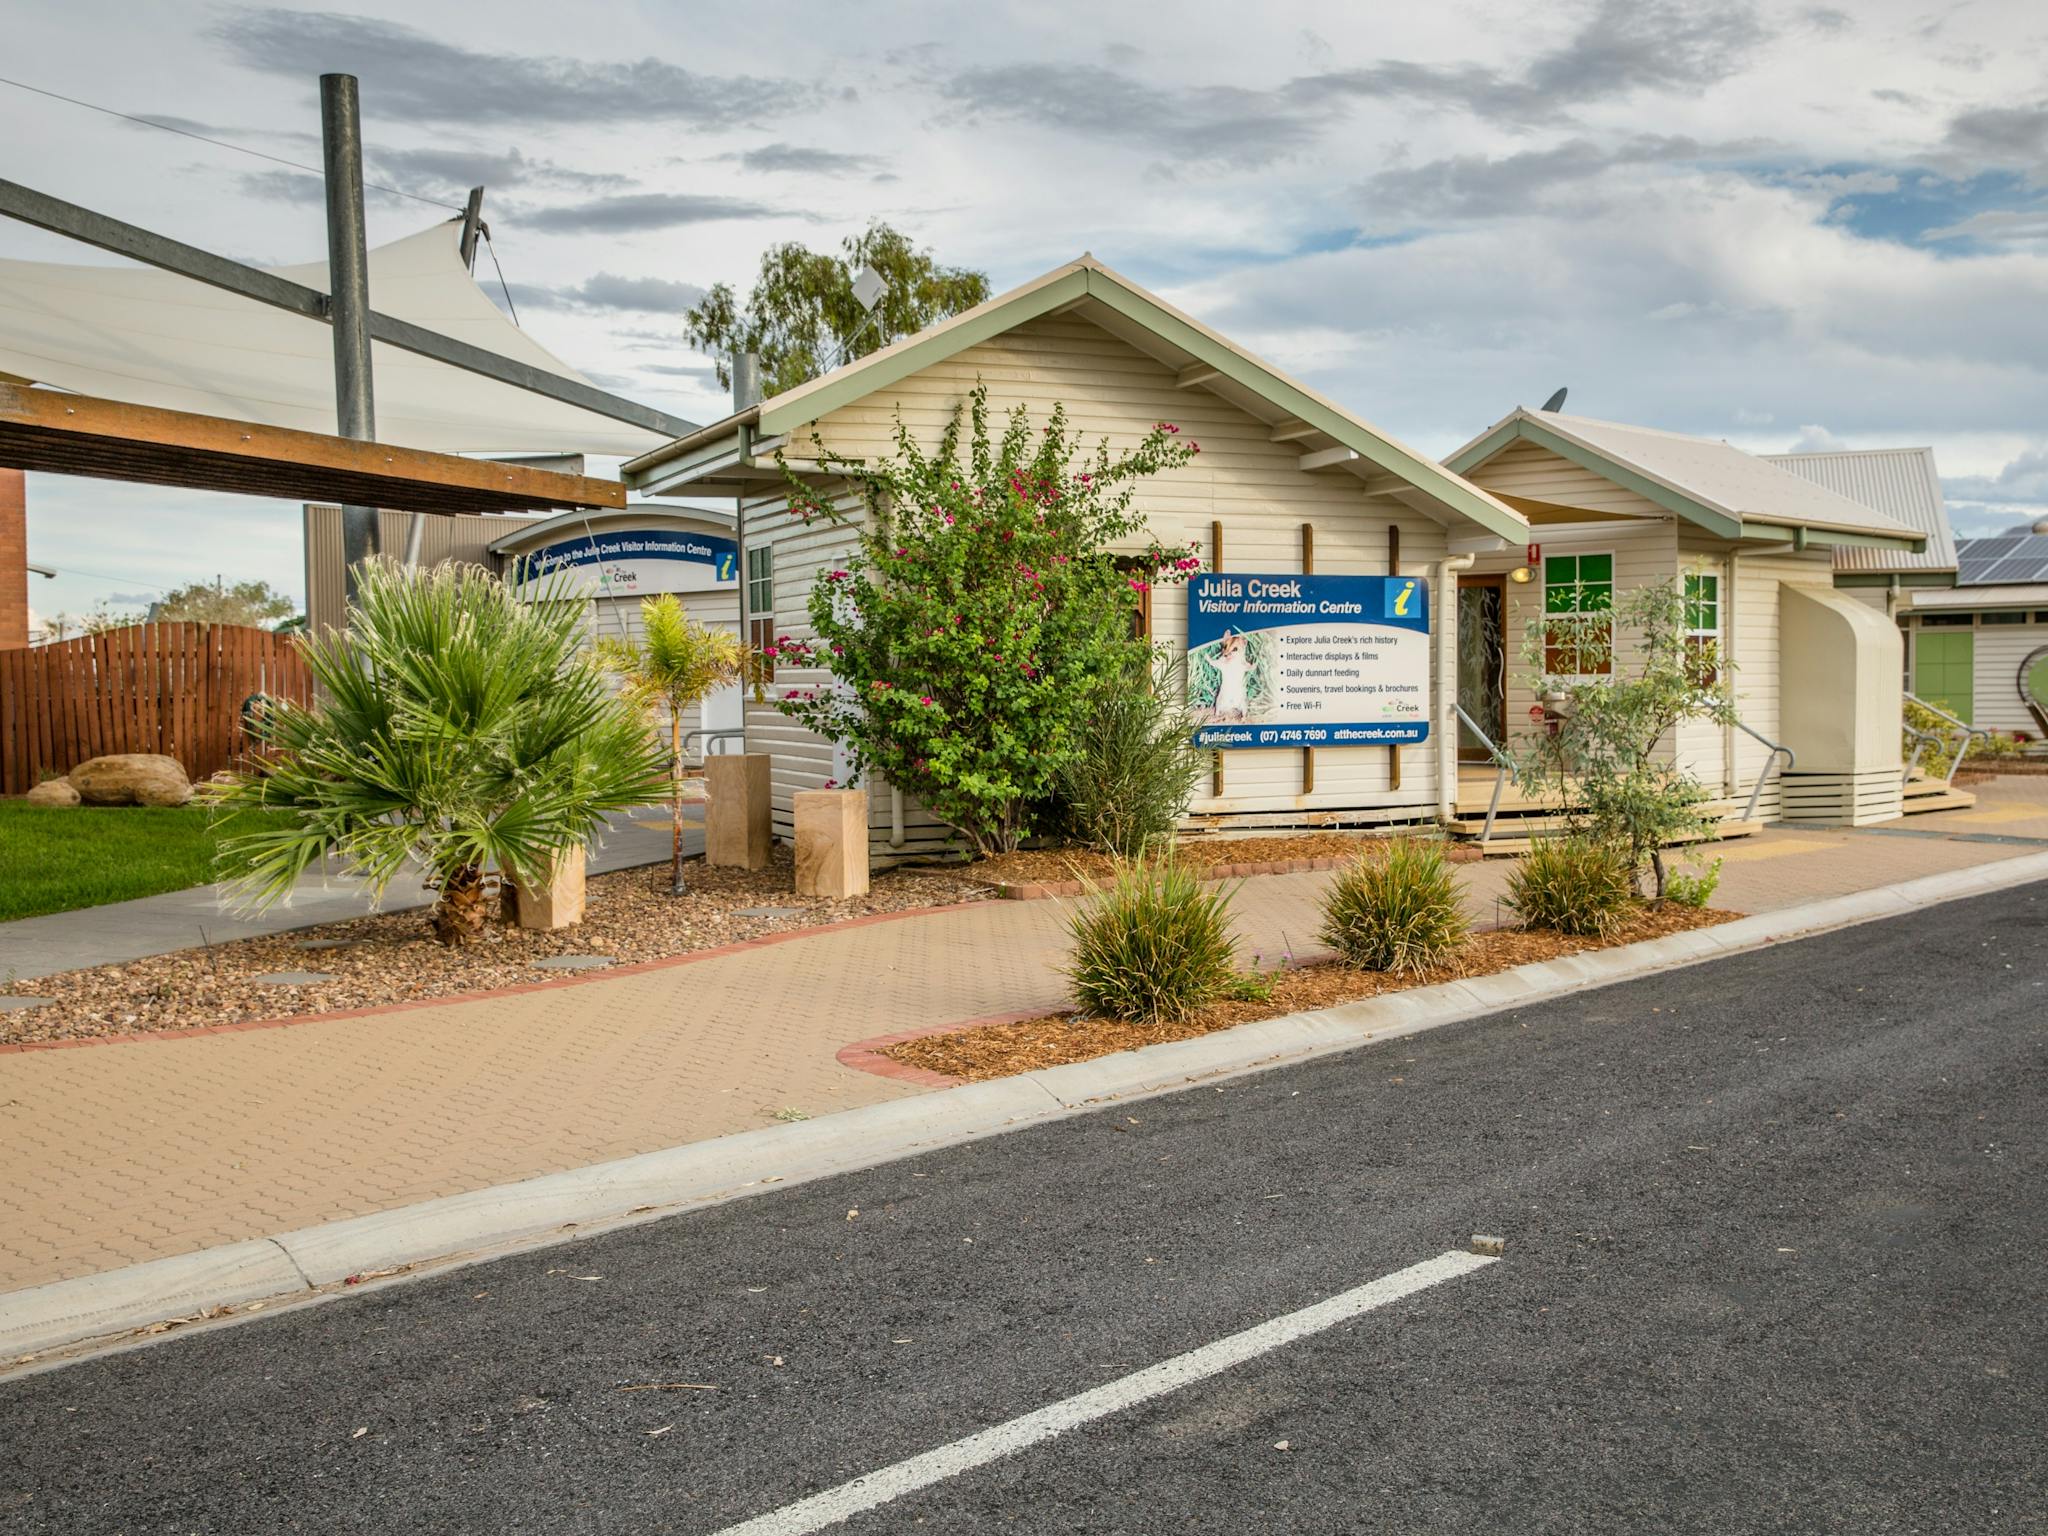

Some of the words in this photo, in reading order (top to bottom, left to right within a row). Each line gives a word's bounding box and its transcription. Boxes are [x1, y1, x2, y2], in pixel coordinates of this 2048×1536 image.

[534, 555, 563, 570] Wcome
[564, 552, 571, 562] to
[572, 550, 583, 560] the
[584, 546, 600, 557] Jula
[600, 542, 621, 554] Creek
[621, 542, 644, 552] Visitor
[645, 541, 686, 553] Information
[687, 544, 712, 556] Centre
[614, 572, 637, 582] Creek
[1198, 579, 1242, 598] Julia
[1248, 580, 1301, 598] Creek
[1198, 600, 1240, 614] Visitor
[1243, 600, 1316, 614] Information
[1320, 601, 1362, 614] Centre
[1286, 636, 1312, 645] Explore
[1314, 636, 1331, 644] Julia
[1332, 636, 1358, 644] Creek's
[1360, 636, 1373, 644] rich
[1375, 636, 1398, 645] history
[1325, 652, 1352, 662] displays
[1362, 652, 1378, 660] films
[1286, 669, 1303, 678] Daily
[1306, 669, 1332, 677] dunnart
[1334, 669, 1359, 678] feeding
[1286, 686, 1322, 694] Souvenirs,
[1325, 685, 1344, 693] travel
[1346, 685, 1376, 694] bookings
[1386, 685, 1418, 693] brochures
[1286, 702, 1302, 710] Free
[1199, 731, 1252, 744] #juliacreek
[1260, 730, 1277, 743] (07)
[1280, 730, 1302, 740] 4746
[1304, 730, 1326, 740] 7690
[1334, 729, 1418, 739] atthecreek.com.au
